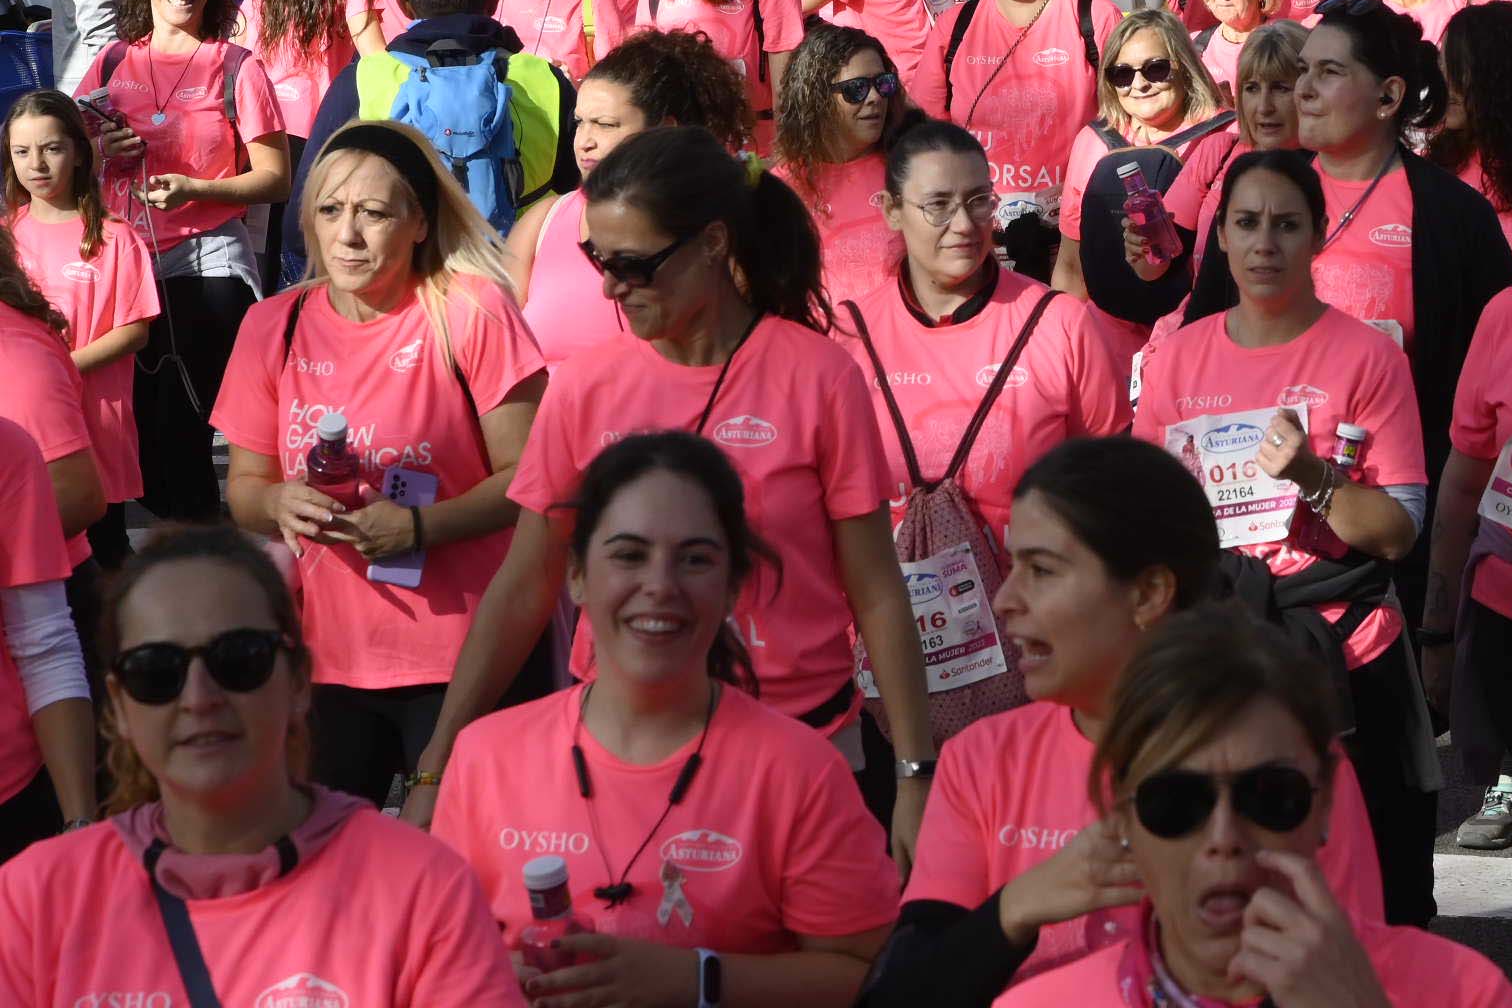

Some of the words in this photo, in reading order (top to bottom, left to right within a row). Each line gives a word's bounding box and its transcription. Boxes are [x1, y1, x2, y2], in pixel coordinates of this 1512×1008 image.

[717, 425, 775, 442] ASTURIANA
[1204, 433, 1260, 449] ASTURIANA
[358, 441, 432, 472] HICAS
[1209, 460, 1257, 484] 016
[1217, 485, 1254, 502] 22164
[1223, 507, 1235, 515] DE
[1235, 505, 1247, 513] LA
[1247, 501, 1276, 512] MUJER
[915, 610, 947, 633] 16
[922, 635, 944, 650] 163
[925, 653, 937, 664] LA
[938, 646, 966, 660] MUJER
[951, 656, 993, 678] Santander
[500, 827, 590, 854] OYSHO
[665, 843, 739, 862] ASTURIANA
